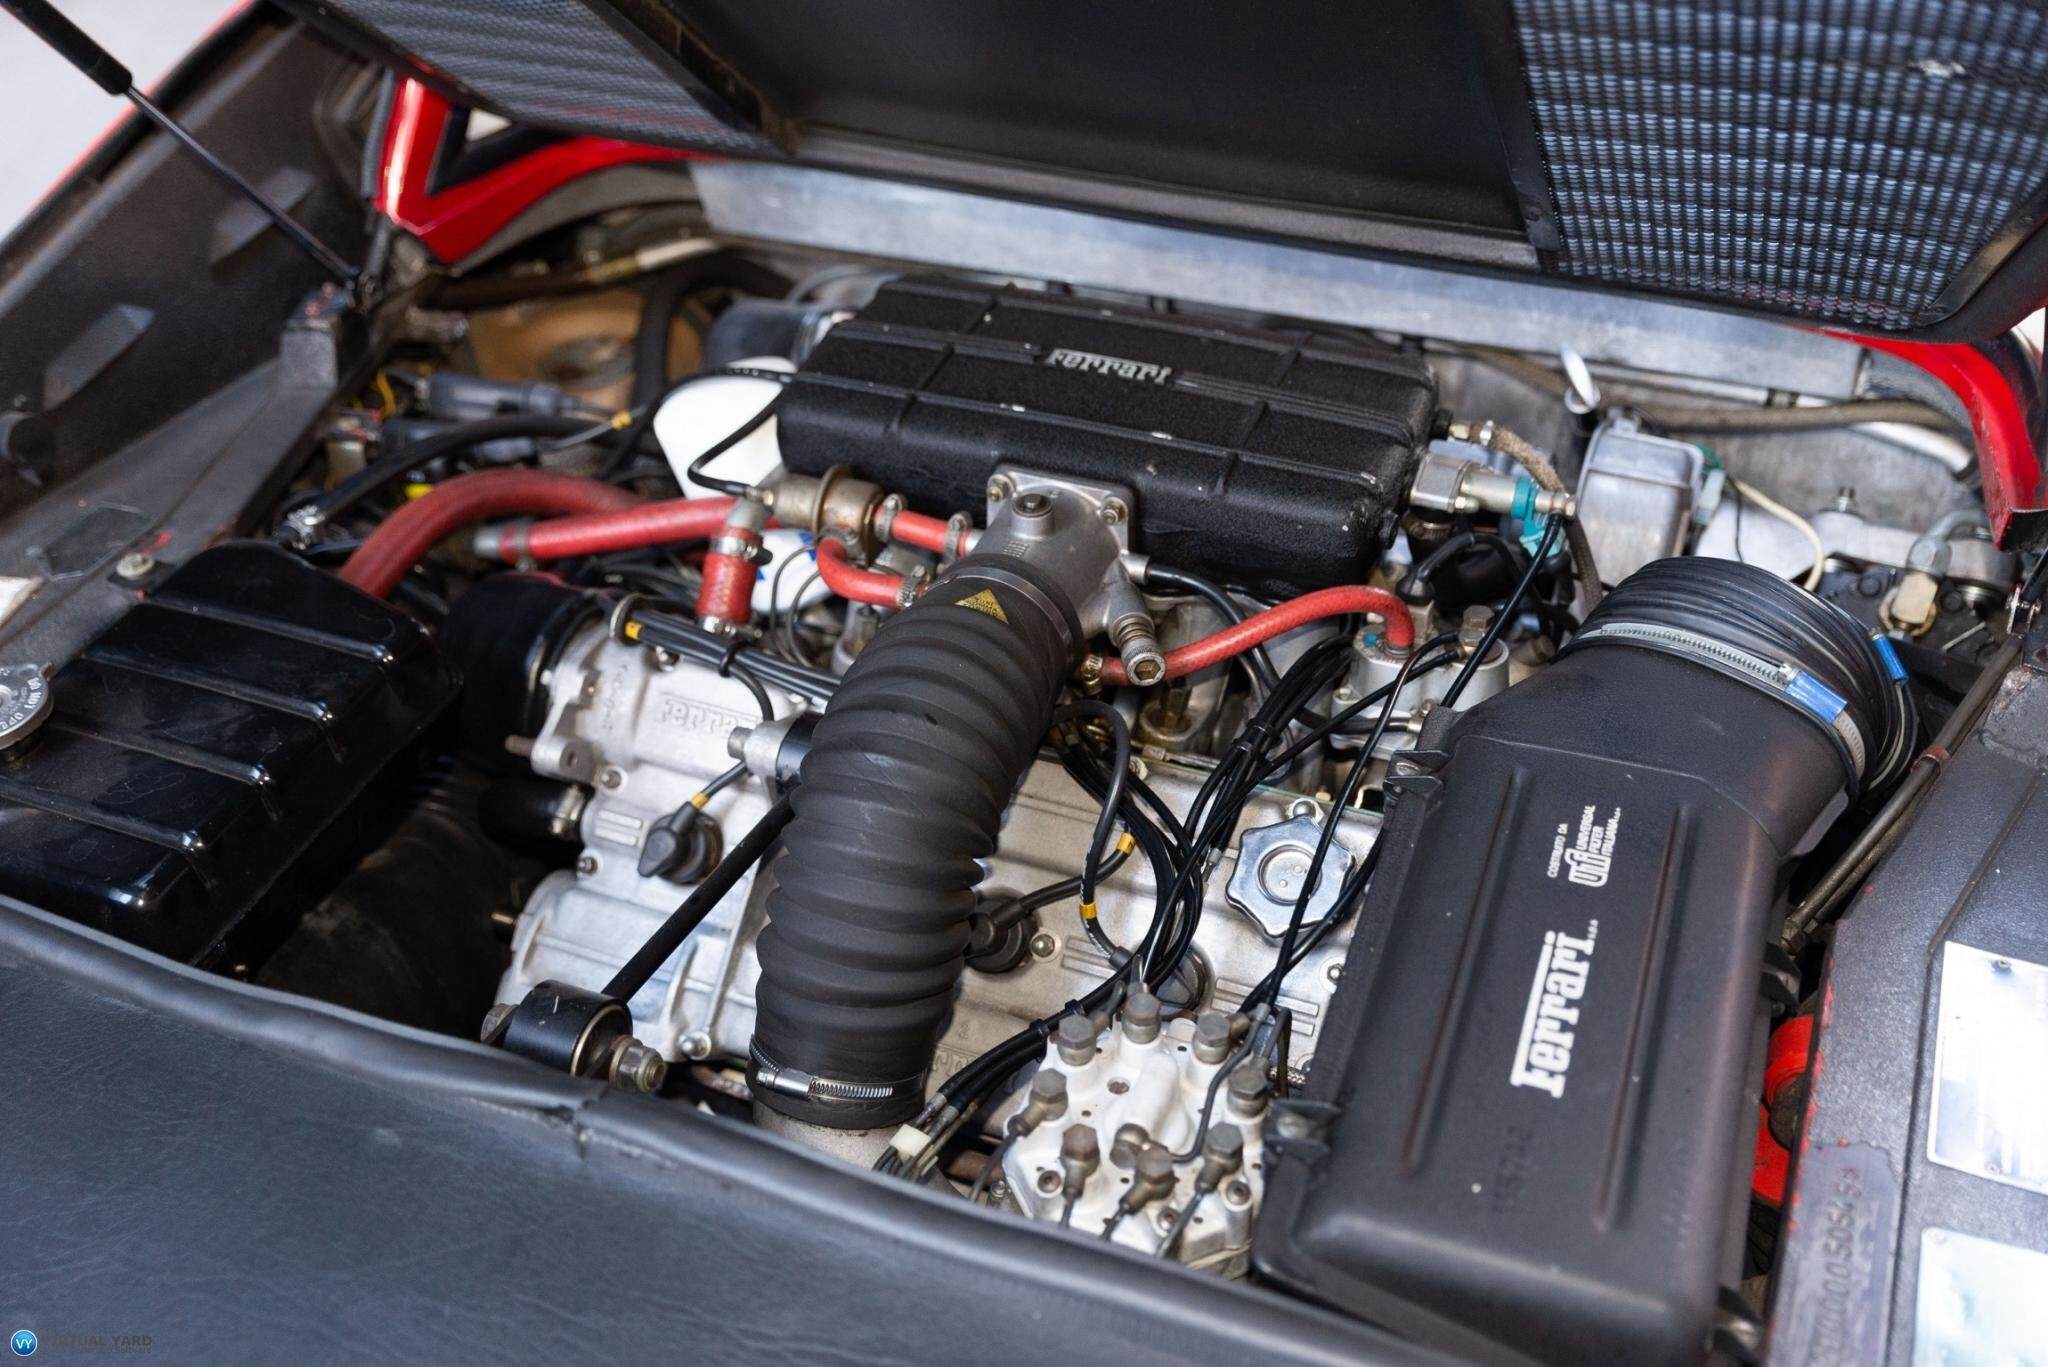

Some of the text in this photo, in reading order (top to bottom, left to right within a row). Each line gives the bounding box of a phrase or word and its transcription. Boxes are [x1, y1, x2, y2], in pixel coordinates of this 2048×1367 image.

[1045, 348, 1173, 385] Ferrari
[656, 691, 761, 738] Ferra
[1510, 930, 1595, 1099] Ferrari
